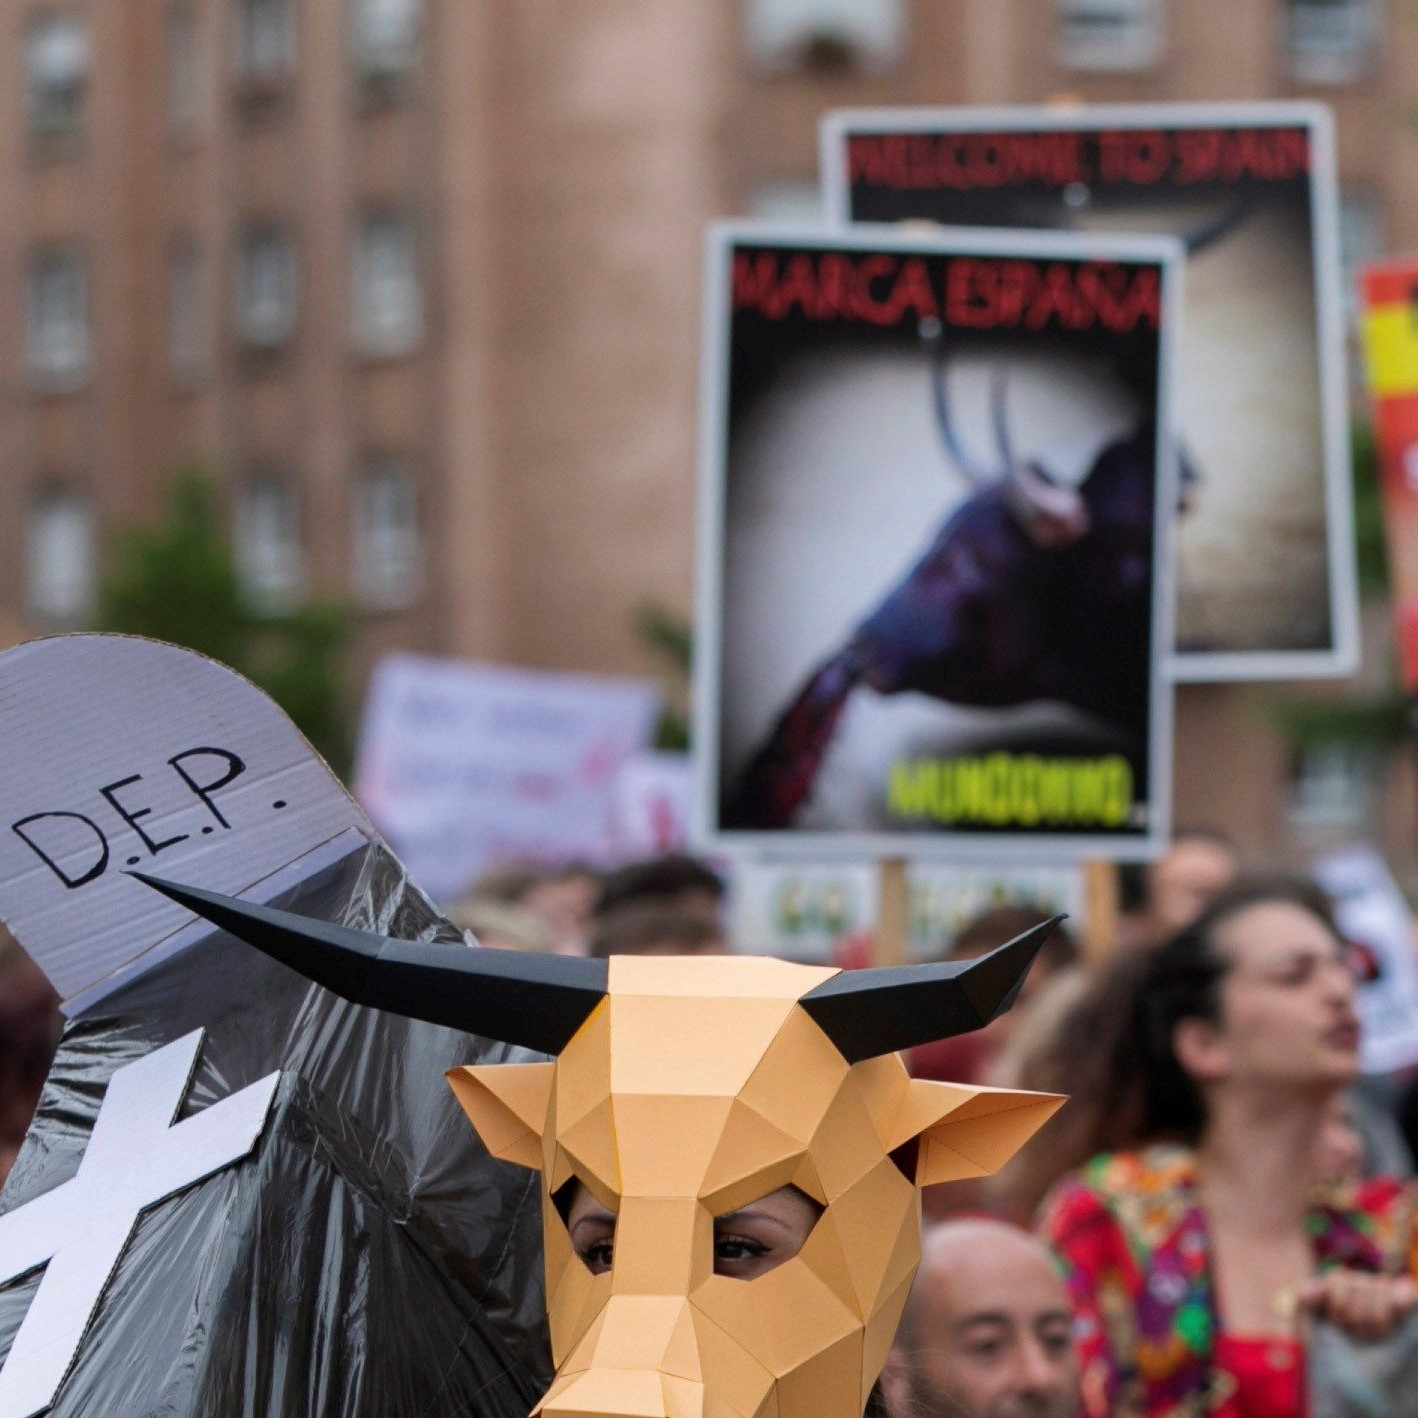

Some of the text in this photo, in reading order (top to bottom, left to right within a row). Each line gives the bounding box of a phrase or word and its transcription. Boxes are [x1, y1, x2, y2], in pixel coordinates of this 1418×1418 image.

[847, 126, 1311, 190] WELCOME TO SPAIN
[732, 252, 1160, 333] MARCA ESPAÑA
